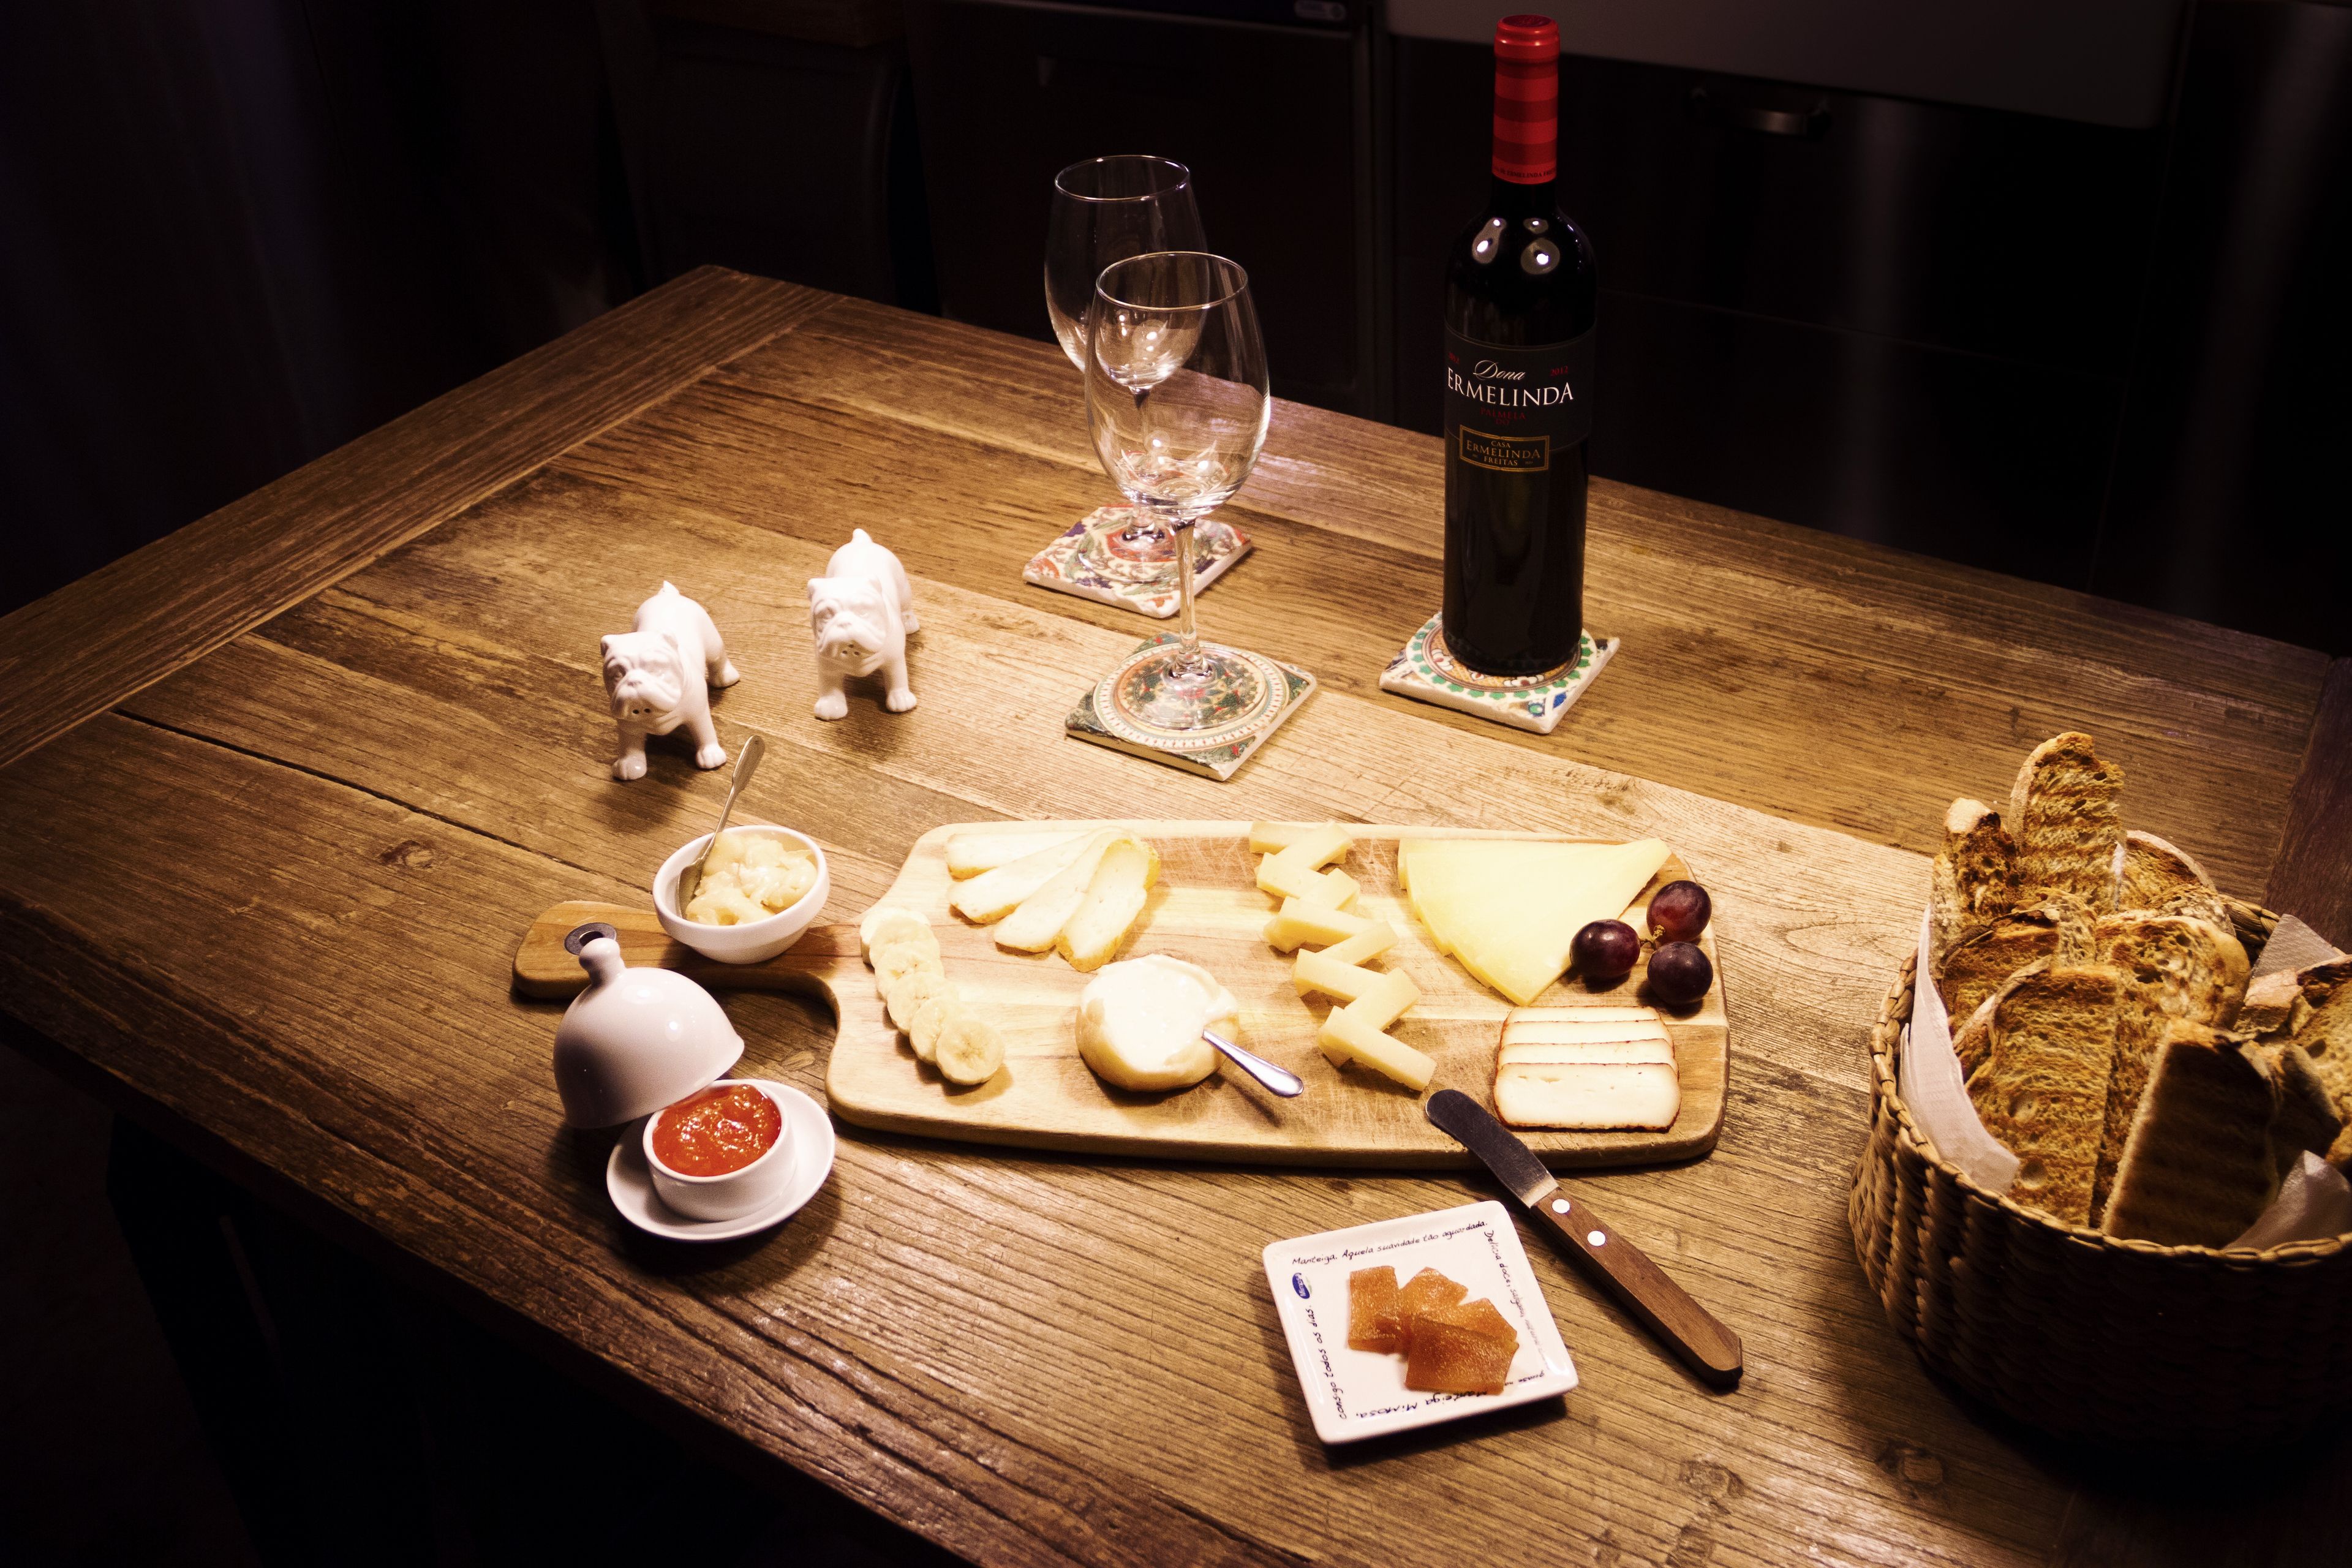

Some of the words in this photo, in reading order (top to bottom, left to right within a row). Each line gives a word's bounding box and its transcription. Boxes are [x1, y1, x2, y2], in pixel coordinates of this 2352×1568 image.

[1472, 360, 1527, 381] Dona
[1447, 366, 1574, 407] ERMELINDA
[1466, 440, 1541, 459] ERMELINDA
[1483, 456, 1518, 466] FREITAS
[1292, 1254, 1338, 1265] Manteiga.
[1342, 1246, 1374, 1261] Aquela
[1377, 1237, 1420, 1252] suavidade
[1423, 1232, 1439, 1242] tão
[1442, 1221, 1488, 1240] aguardada.
[1313, 1332, 1323, 1344] os
[1318, 1348, 1334, 1378] todos
